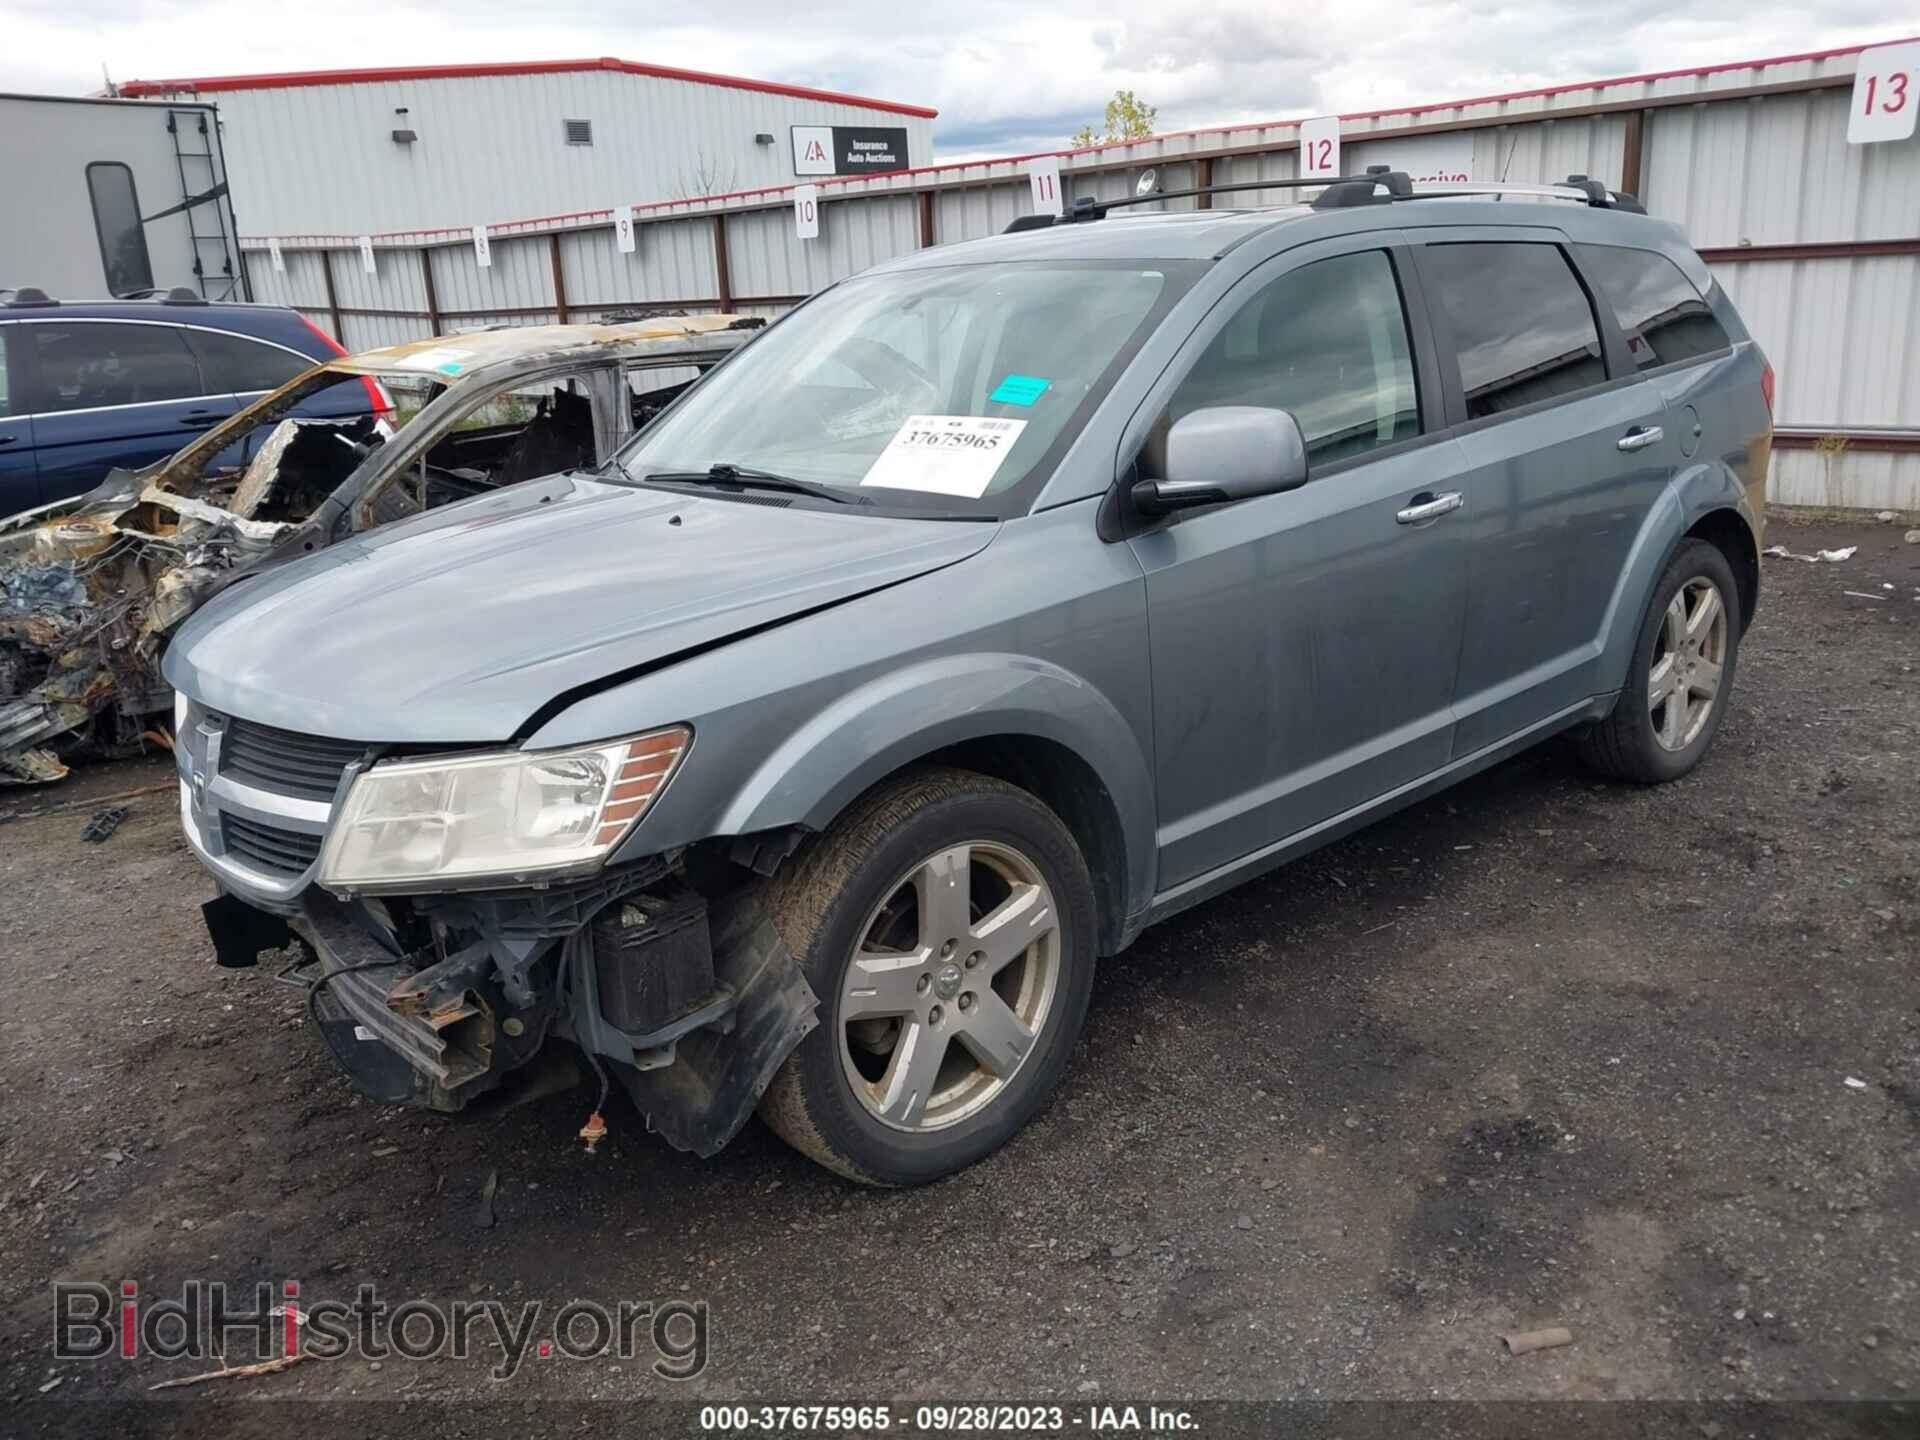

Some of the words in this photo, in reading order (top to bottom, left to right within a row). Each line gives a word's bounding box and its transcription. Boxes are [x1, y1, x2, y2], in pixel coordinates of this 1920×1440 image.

[1864, 73, 1908, 115] 13
[852, 140, 889, 151] Insurance
[1307, 138, 1333, 171] 12
[847, 152, 865, 163] Auto
[865, 152, 896, 163] Auctions
[1037, 174, 1054, 201] 11
[798, 200, 815, 224] 10
[620, 219, 629, 239] 9
[903, 430, 1002, 450] 37675965
